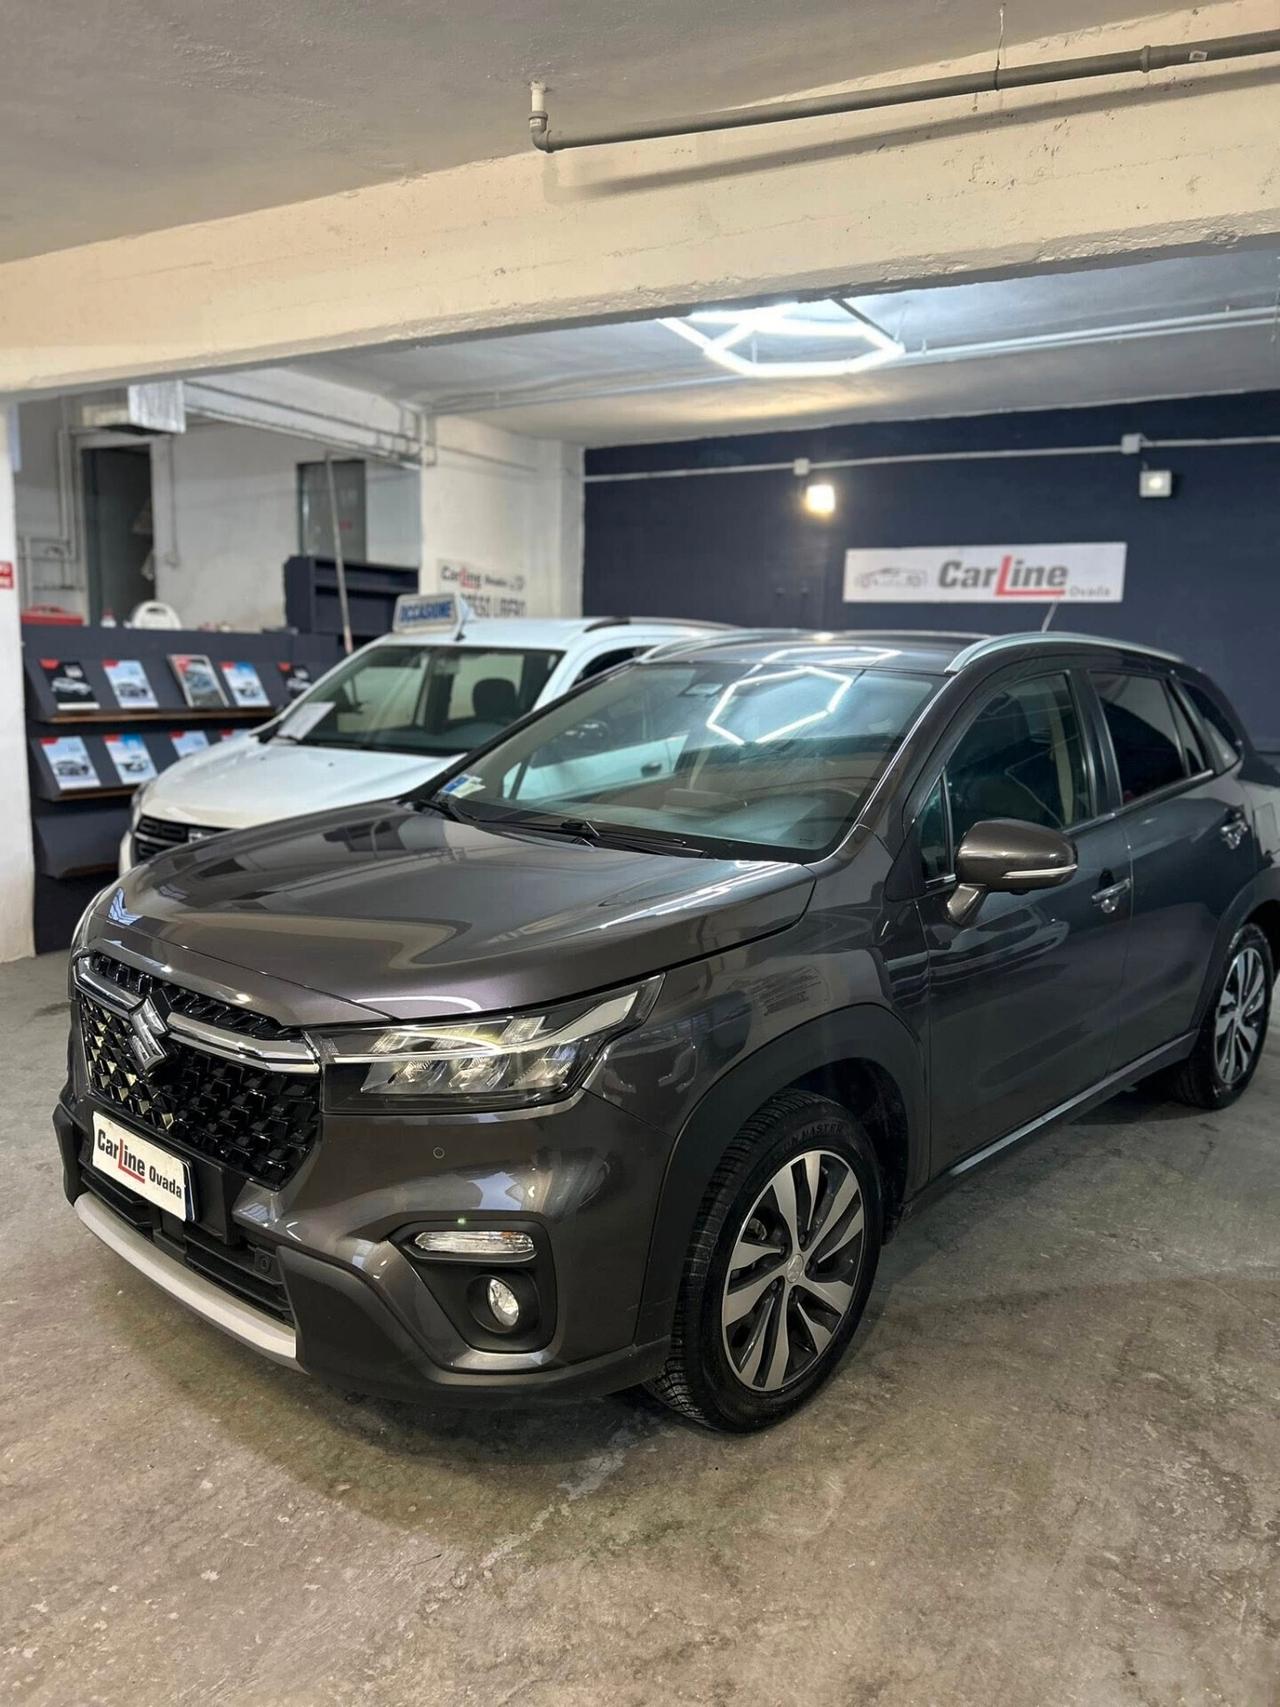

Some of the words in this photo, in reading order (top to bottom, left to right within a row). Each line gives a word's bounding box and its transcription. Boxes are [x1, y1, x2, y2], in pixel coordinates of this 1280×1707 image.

[937, 555, 1069, 597] CarLine
[97, 1128, 145, 1184] CarLine
[149, 1165, 182, 1199] Ovada
